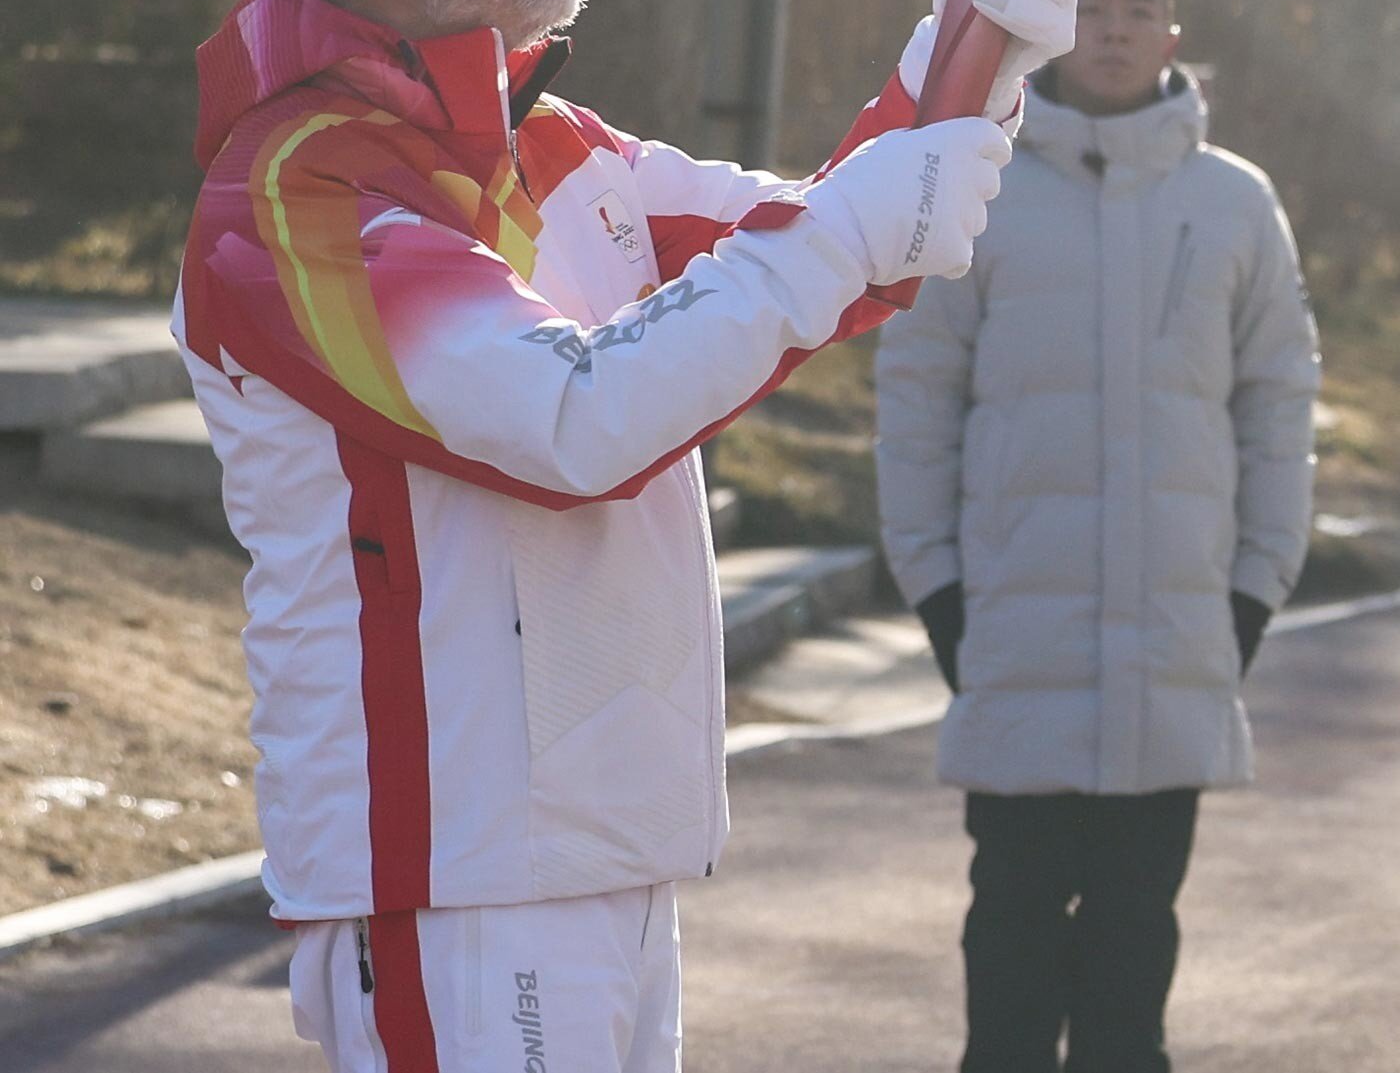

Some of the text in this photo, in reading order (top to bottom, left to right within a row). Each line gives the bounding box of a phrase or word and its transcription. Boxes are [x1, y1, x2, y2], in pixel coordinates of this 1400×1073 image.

[904, 152, 940, 265] BEIJING 2022
[592, 279, 720, 351] 2022
